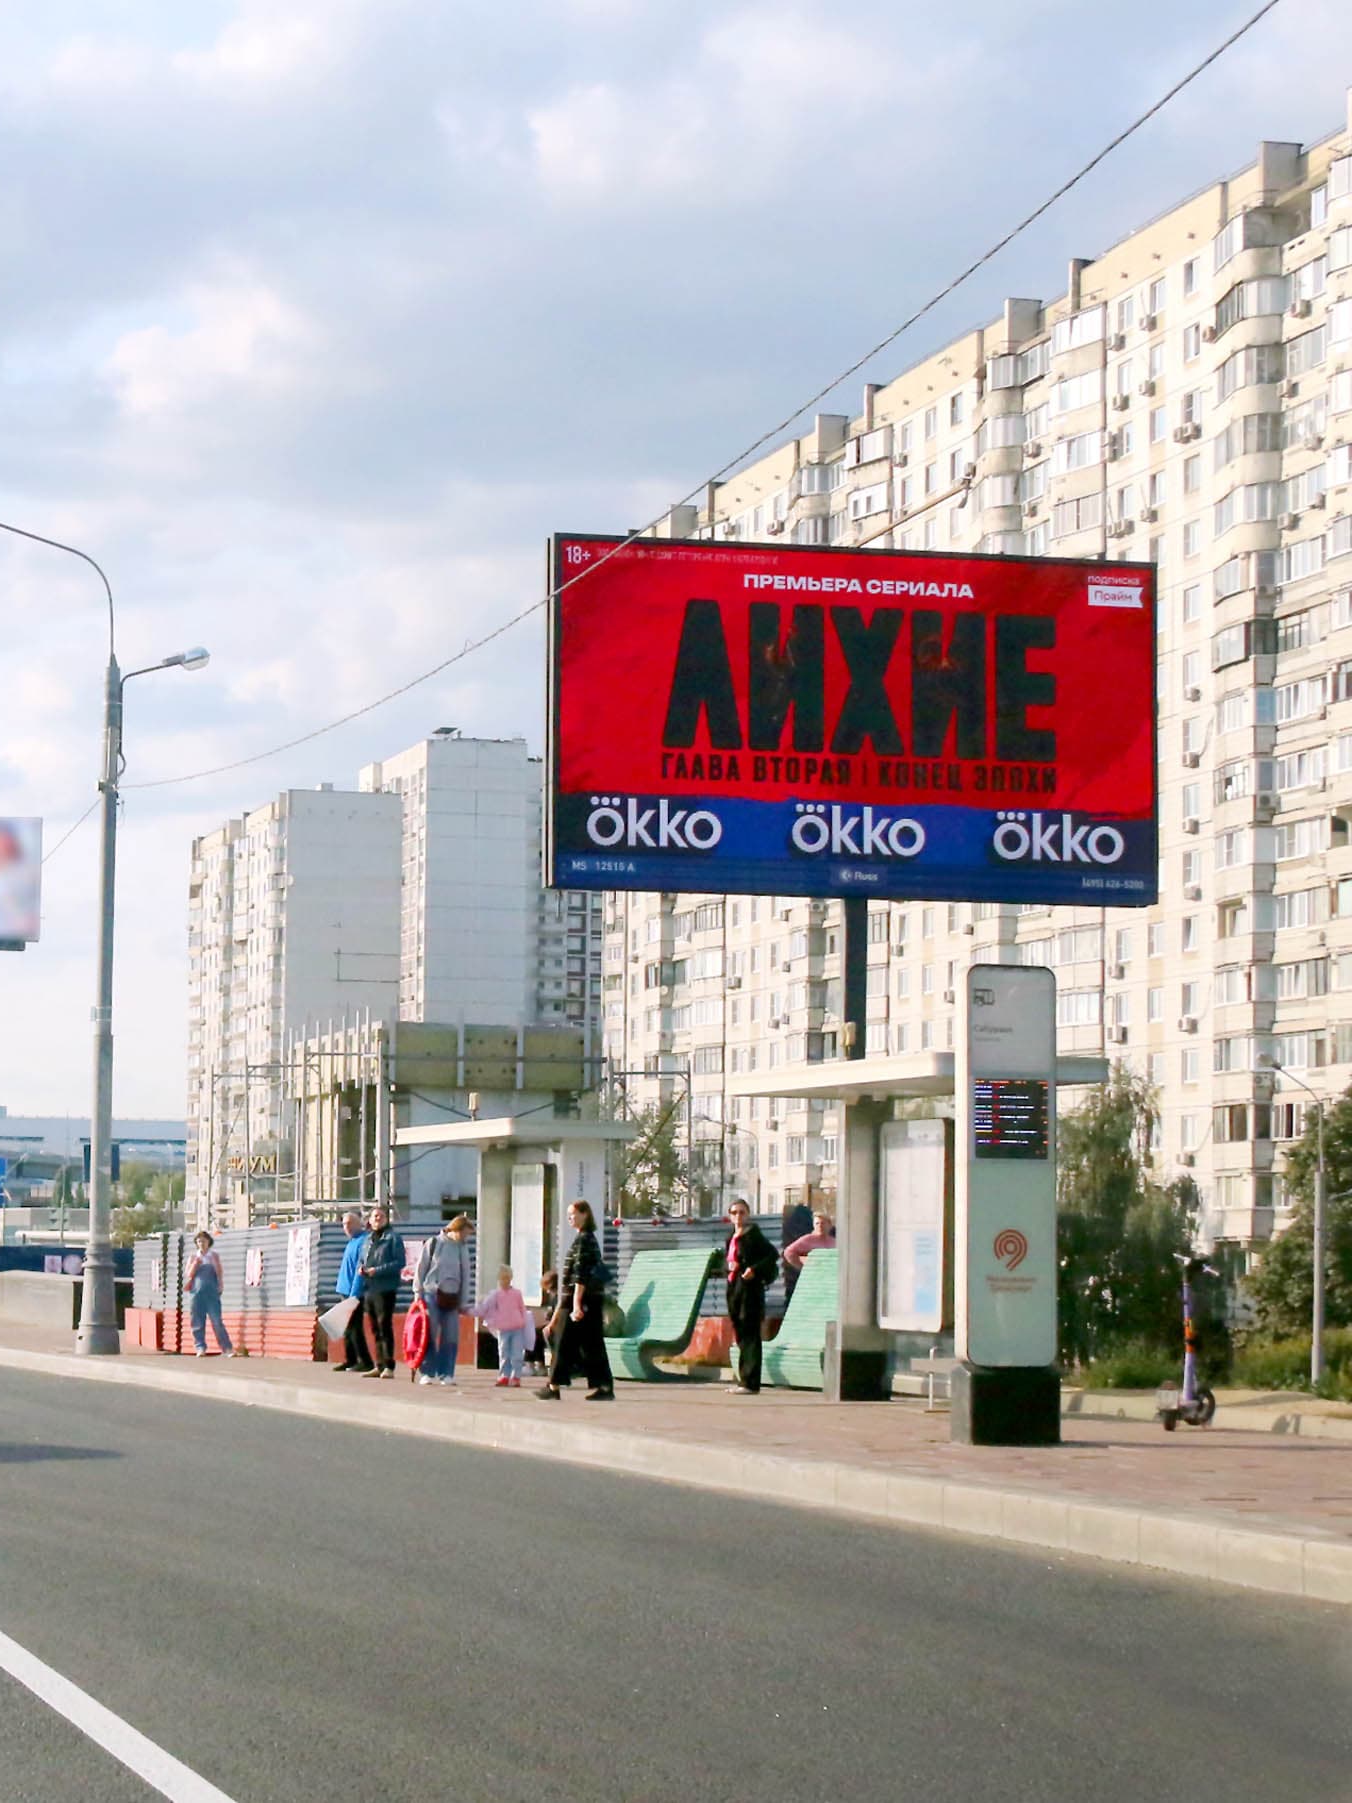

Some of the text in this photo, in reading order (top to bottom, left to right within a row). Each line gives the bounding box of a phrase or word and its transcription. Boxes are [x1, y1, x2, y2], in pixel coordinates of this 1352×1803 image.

[566, 546, 591, 564] 18+
[743, 573, 975, 599] ПРЕМЬЕРА СЕРИАЛА
[1094, 590, 1134, 604] Прайм
[661, 598, 1058, 761] ЛИХИЕ
[661, 752, 741, 782] ГЛАВА
[752, 755, 849, 786] ВТОРАЯ
[878, 761, 963, 792] КОНЕЦ
[975, 765, 1057, 795] ЭПОХИ
